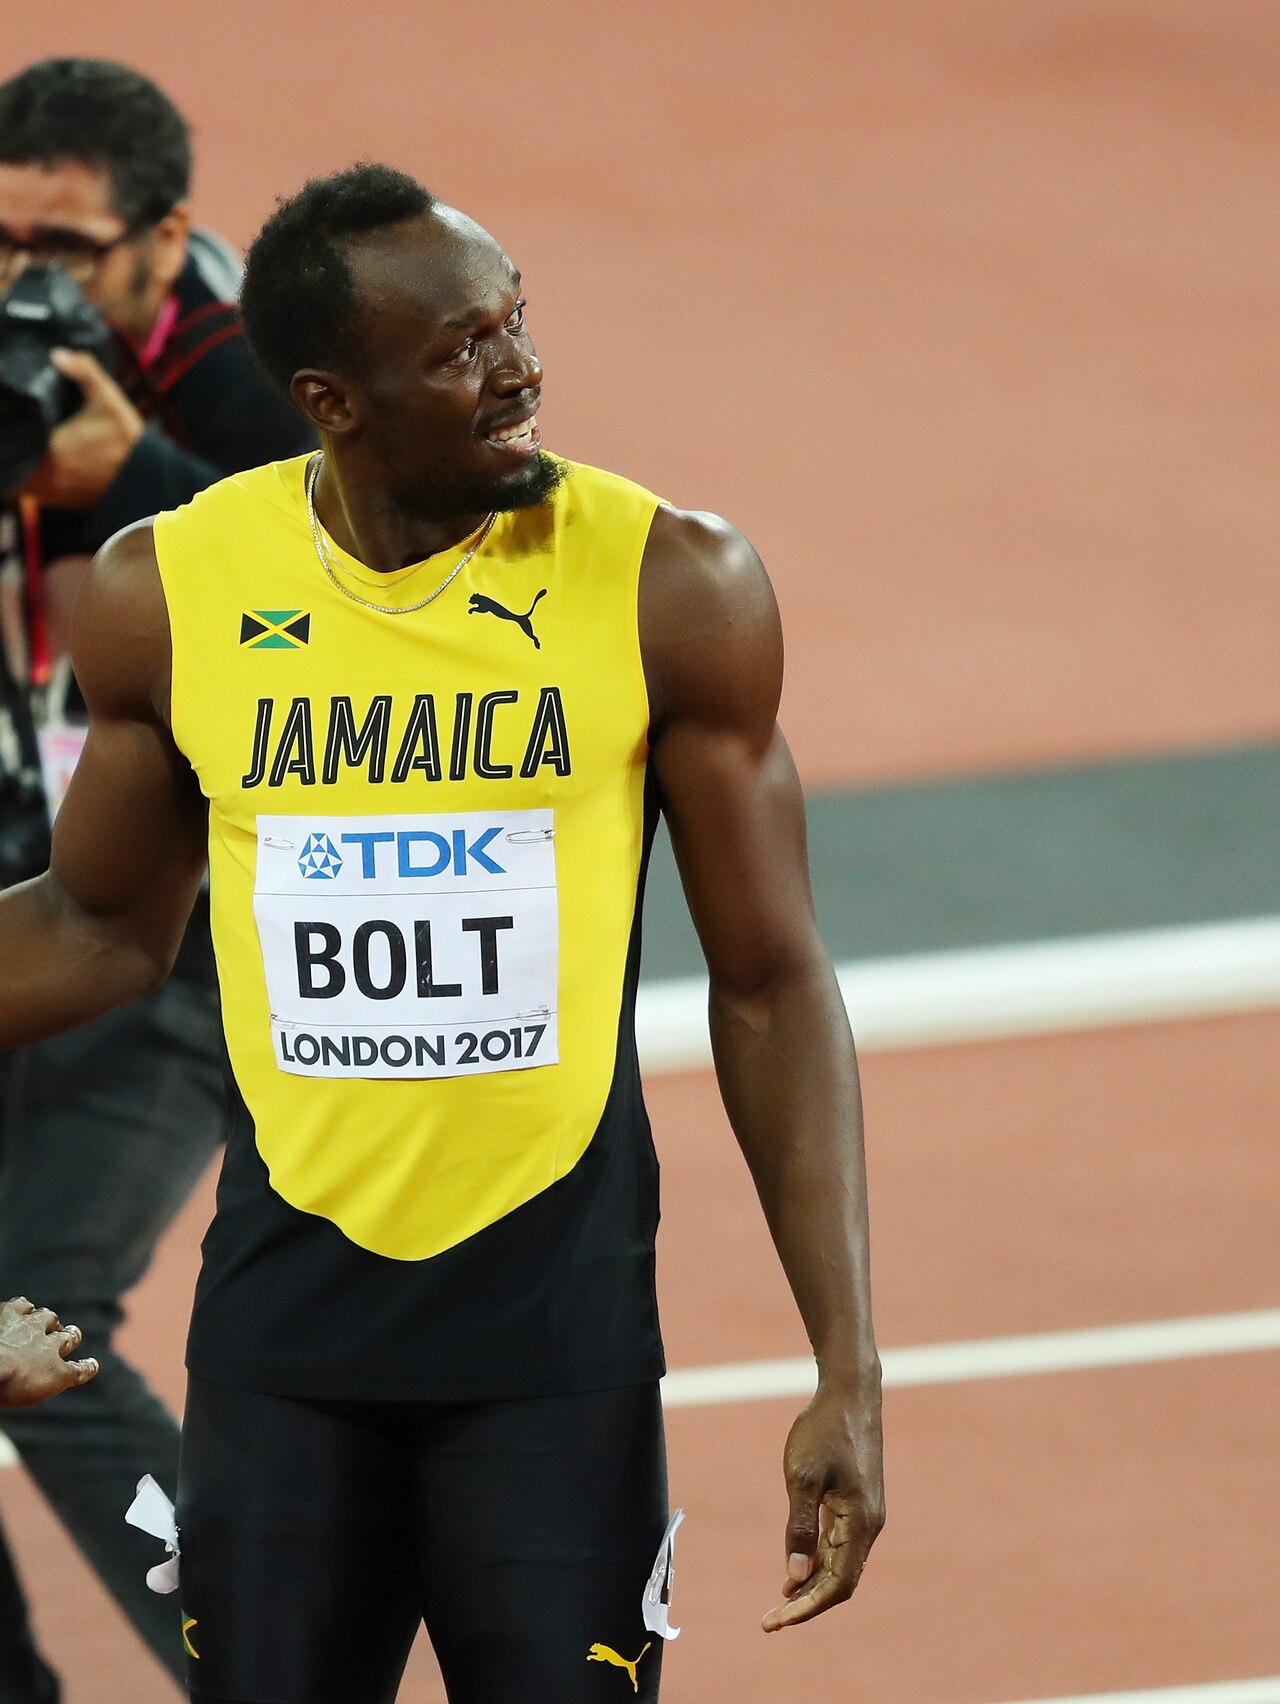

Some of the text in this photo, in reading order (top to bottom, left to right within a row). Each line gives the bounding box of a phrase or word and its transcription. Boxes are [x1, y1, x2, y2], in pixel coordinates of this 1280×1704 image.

[241, 686, 572, 789] JAMAICA
[341, 826, 508, 879] TDK
[293, 915, 514, 1001] BOLT
[280, 1023, 548, 1068] LONDON 2017
